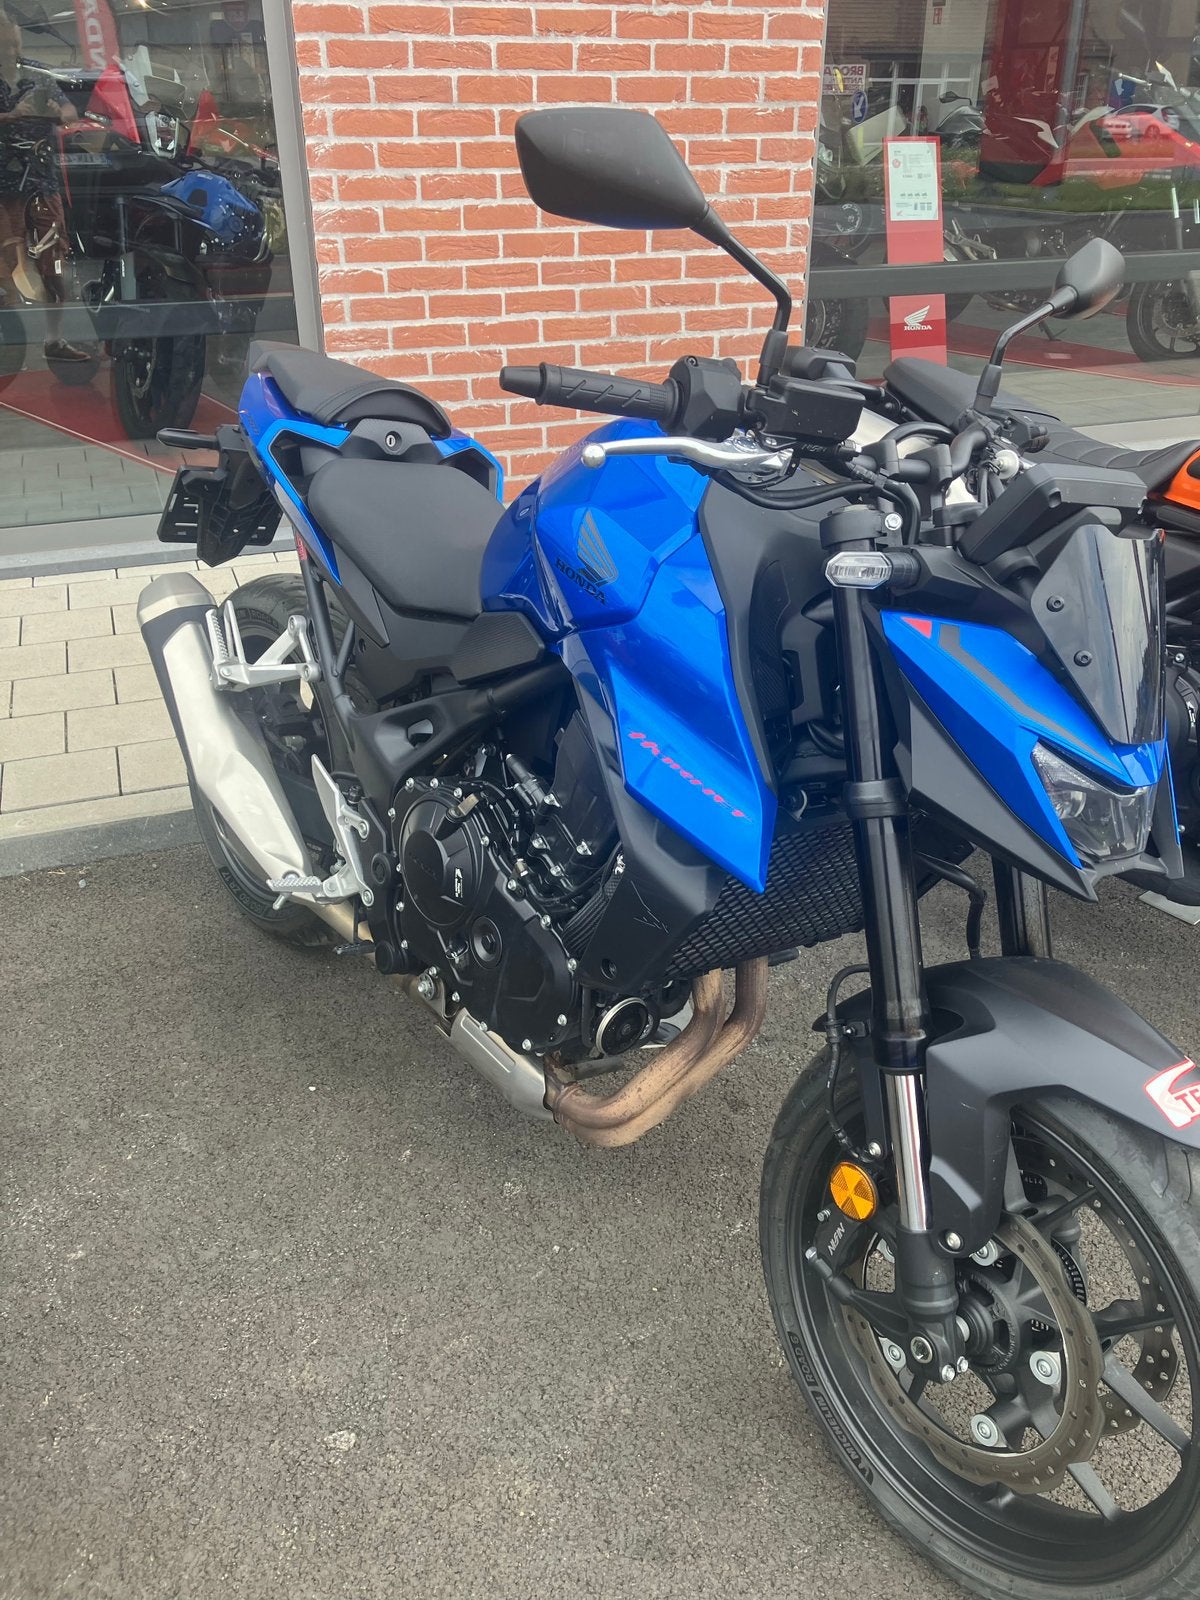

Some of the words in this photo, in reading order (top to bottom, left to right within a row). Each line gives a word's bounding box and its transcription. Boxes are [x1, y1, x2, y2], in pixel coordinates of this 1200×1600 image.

[555, 557, 606, 606] HONDA
[794, 1347, 815, 1384] ROAD
[815, 1394, 861, 1461] MICHELIN
